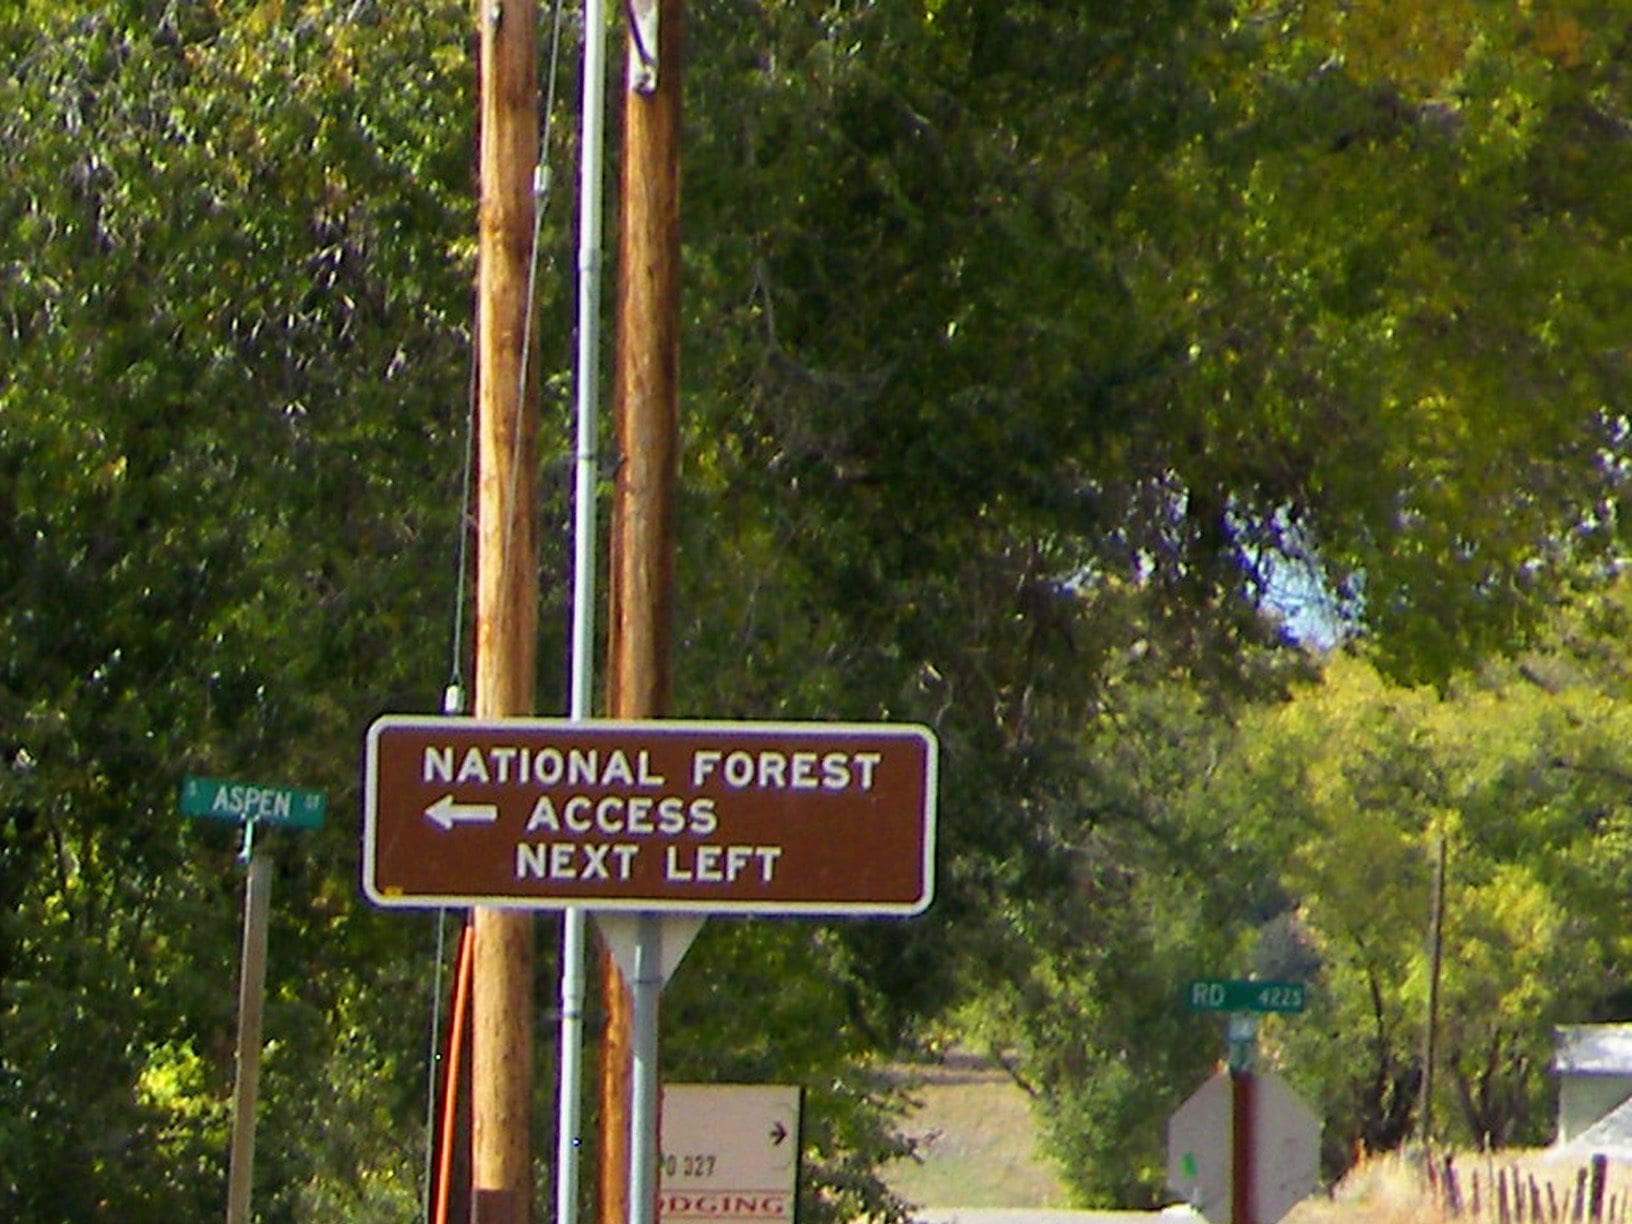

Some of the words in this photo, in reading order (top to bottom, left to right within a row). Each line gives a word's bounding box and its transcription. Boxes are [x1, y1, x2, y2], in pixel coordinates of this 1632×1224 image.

[423, 746, 665, 788] NATIONAL
[691, 750, 882, 790] FOREST
[211, 782, 292, 818] ASPEN
[525, 796, 718, 835] ACCESS
[515, 843, 639, 881] NEXT
[666, 845, 782, 883] LEFT
[1191, 981, 1226, 1007] RD
